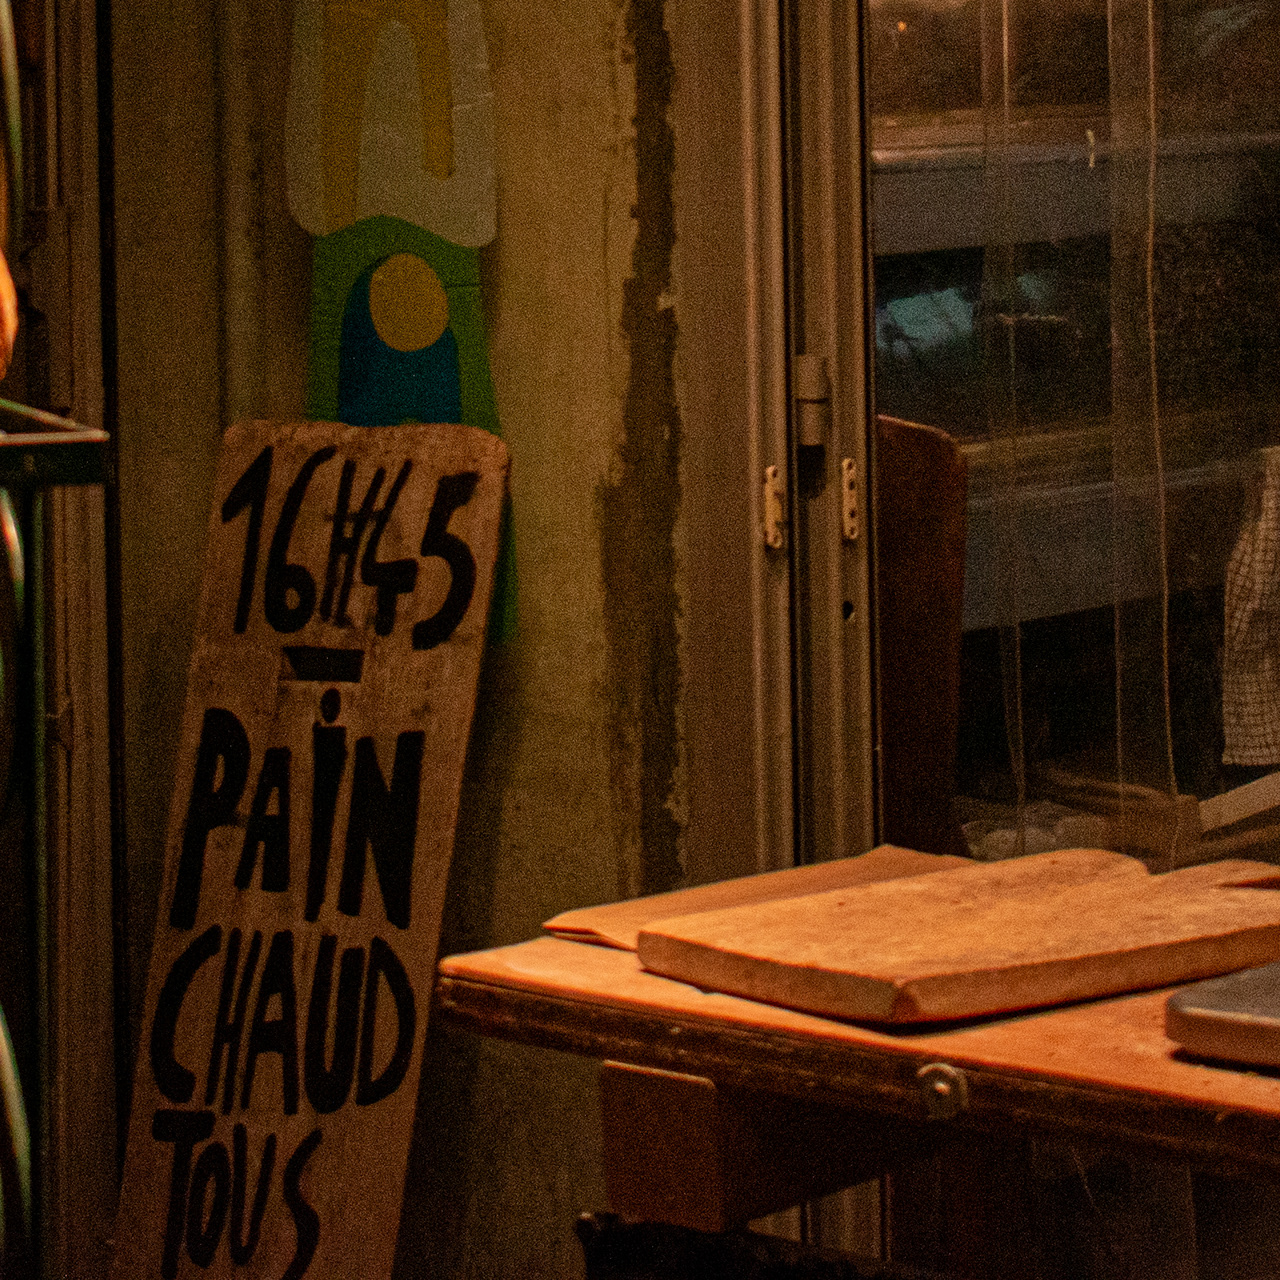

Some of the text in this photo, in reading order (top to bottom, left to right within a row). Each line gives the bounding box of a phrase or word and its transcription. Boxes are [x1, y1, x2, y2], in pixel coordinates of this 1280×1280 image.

[220, 445, 478, 650] 16H45
[150, 925, 415, 1117] CHAUD
[152, 1109, 324, 1280] TOUS
